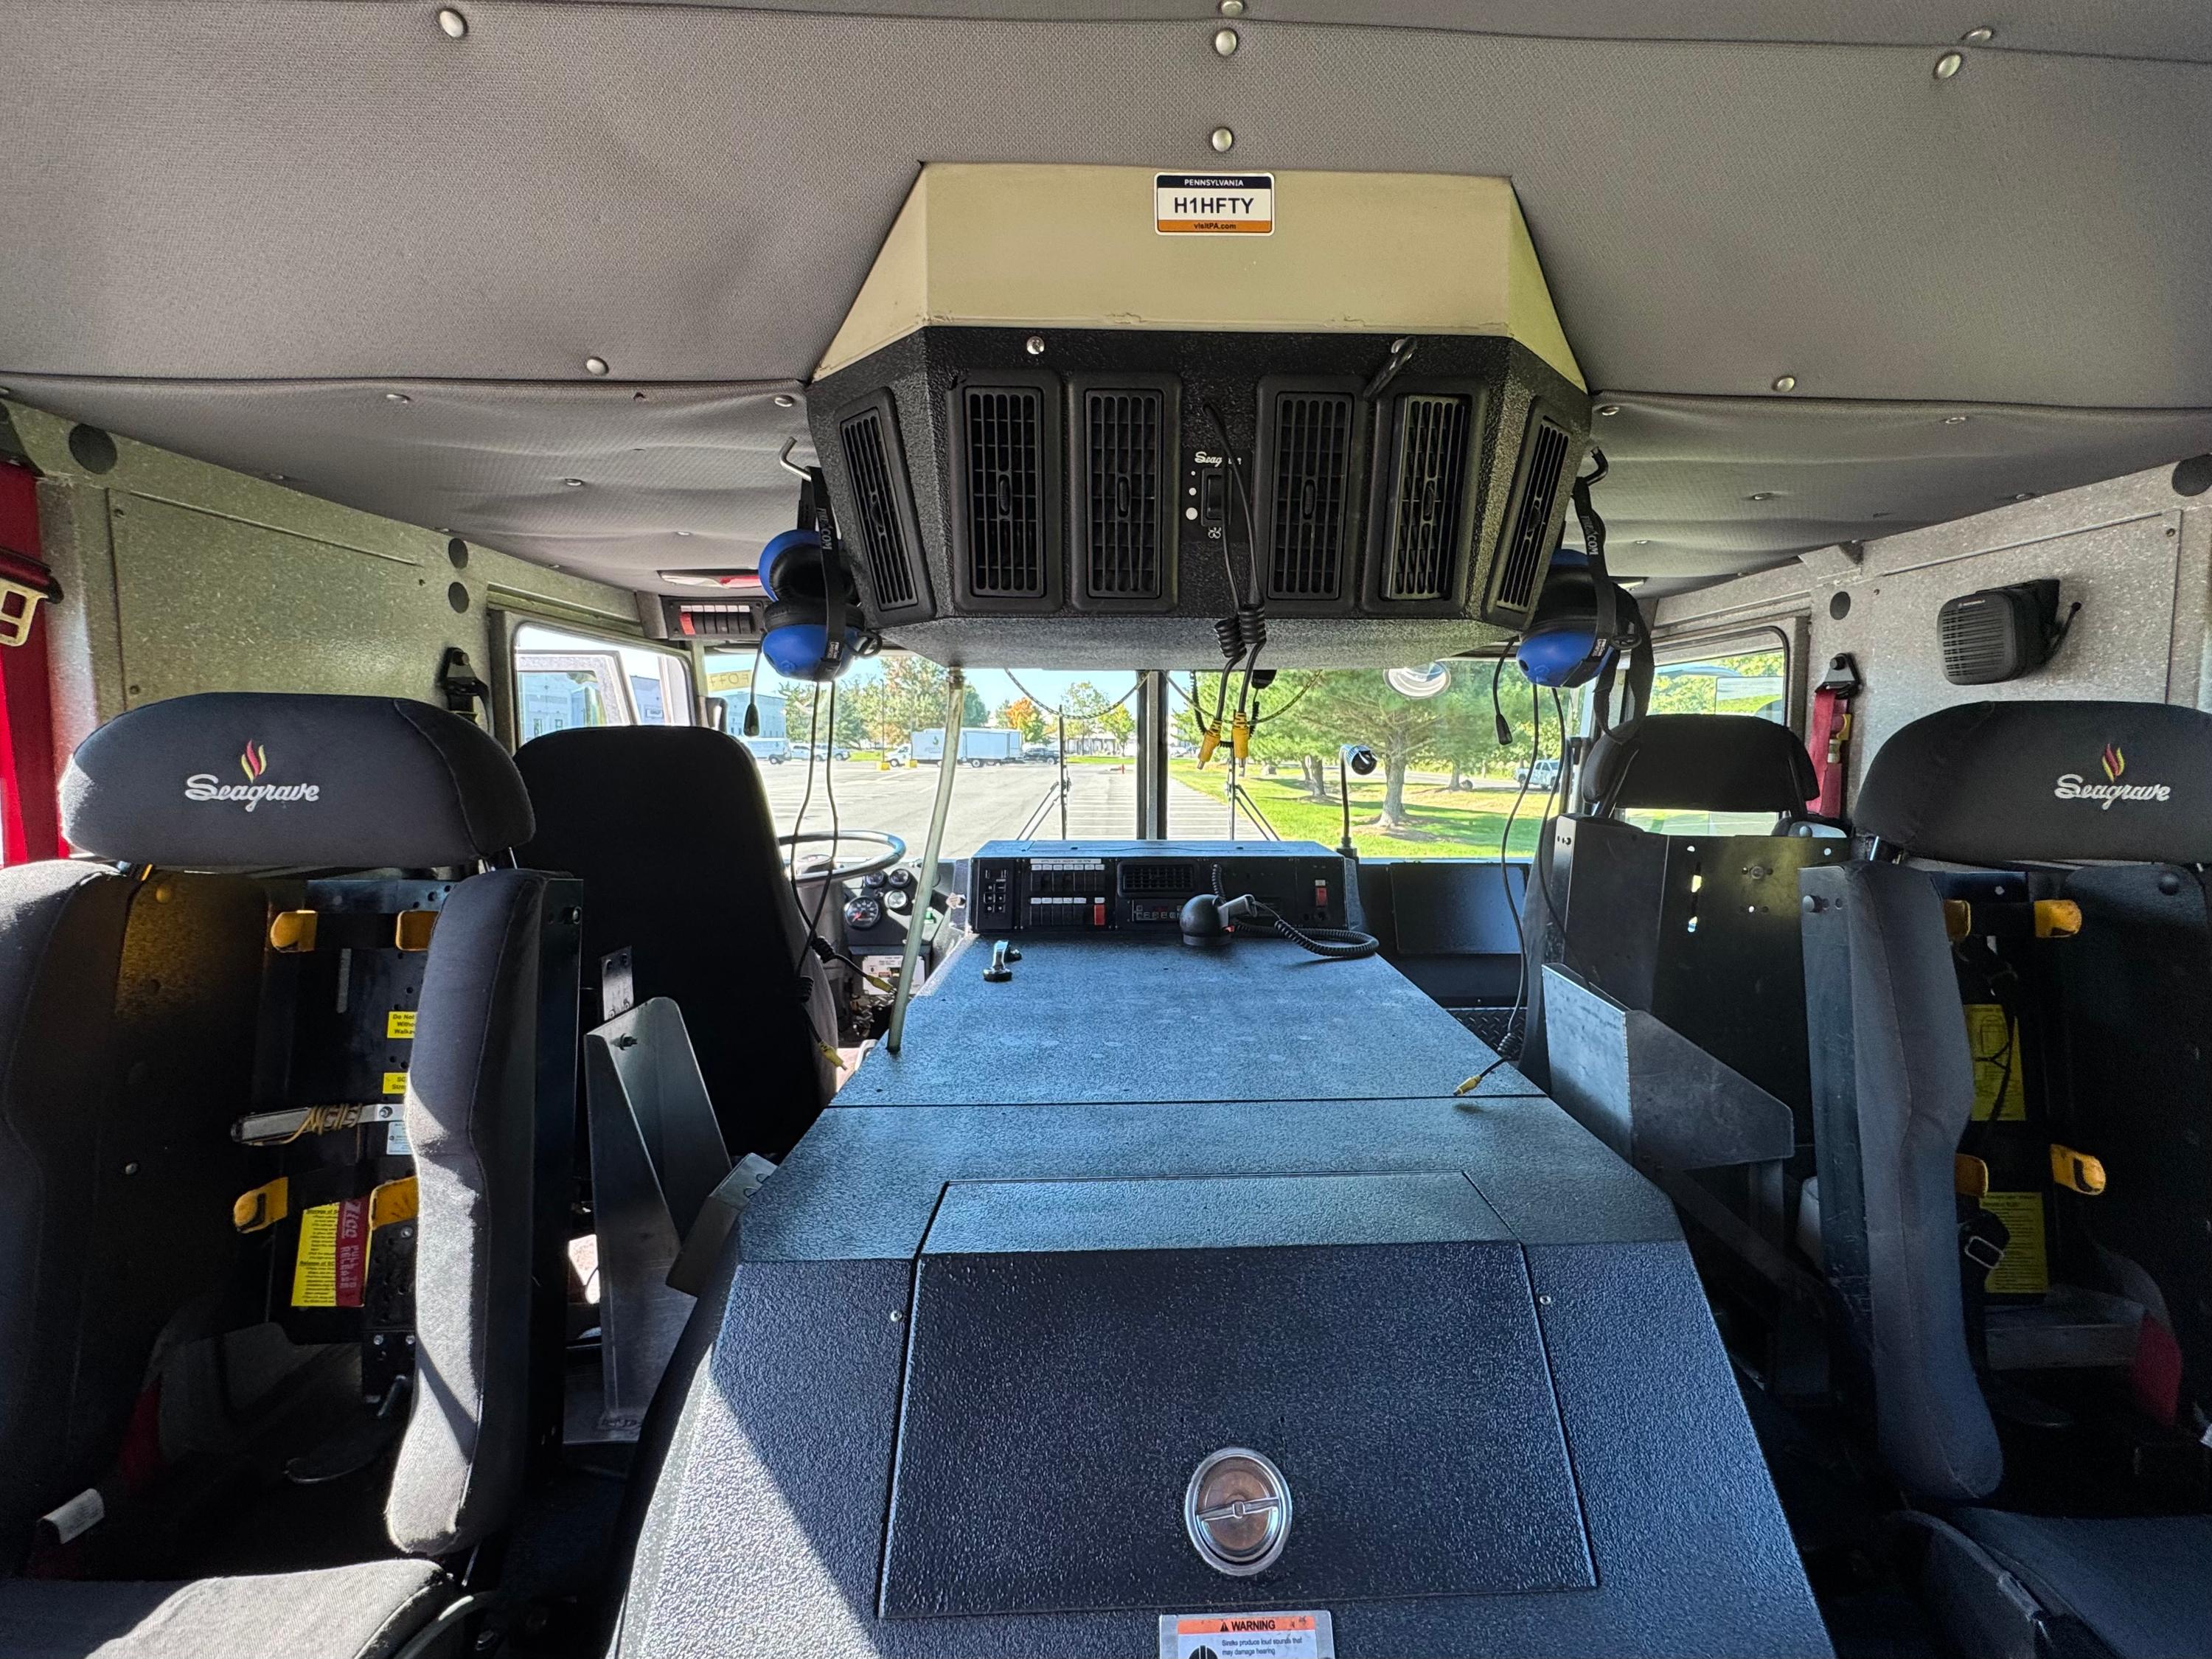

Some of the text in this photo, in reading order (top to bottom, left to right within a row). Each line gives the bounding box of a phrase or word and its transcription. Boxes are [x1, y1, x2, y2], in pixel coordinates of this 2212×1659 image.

[1184, 178, 1244, 187] PENNSYLVANIA
[1175, 197, 1254, 214] H1HFTY
[184, 773, 320, 813] Seagrave
[2054, 773, 2171, 810] Seagrave
[1231, 1620, 1276, 1631] WARNING
[1239, 1638, 1260, 1647] produce
[1273, 1637, 1292, 1645] sounds
[1234, 1648, 1255, 1657] damage
[1256, 1647, 1276, 1657] hearing
